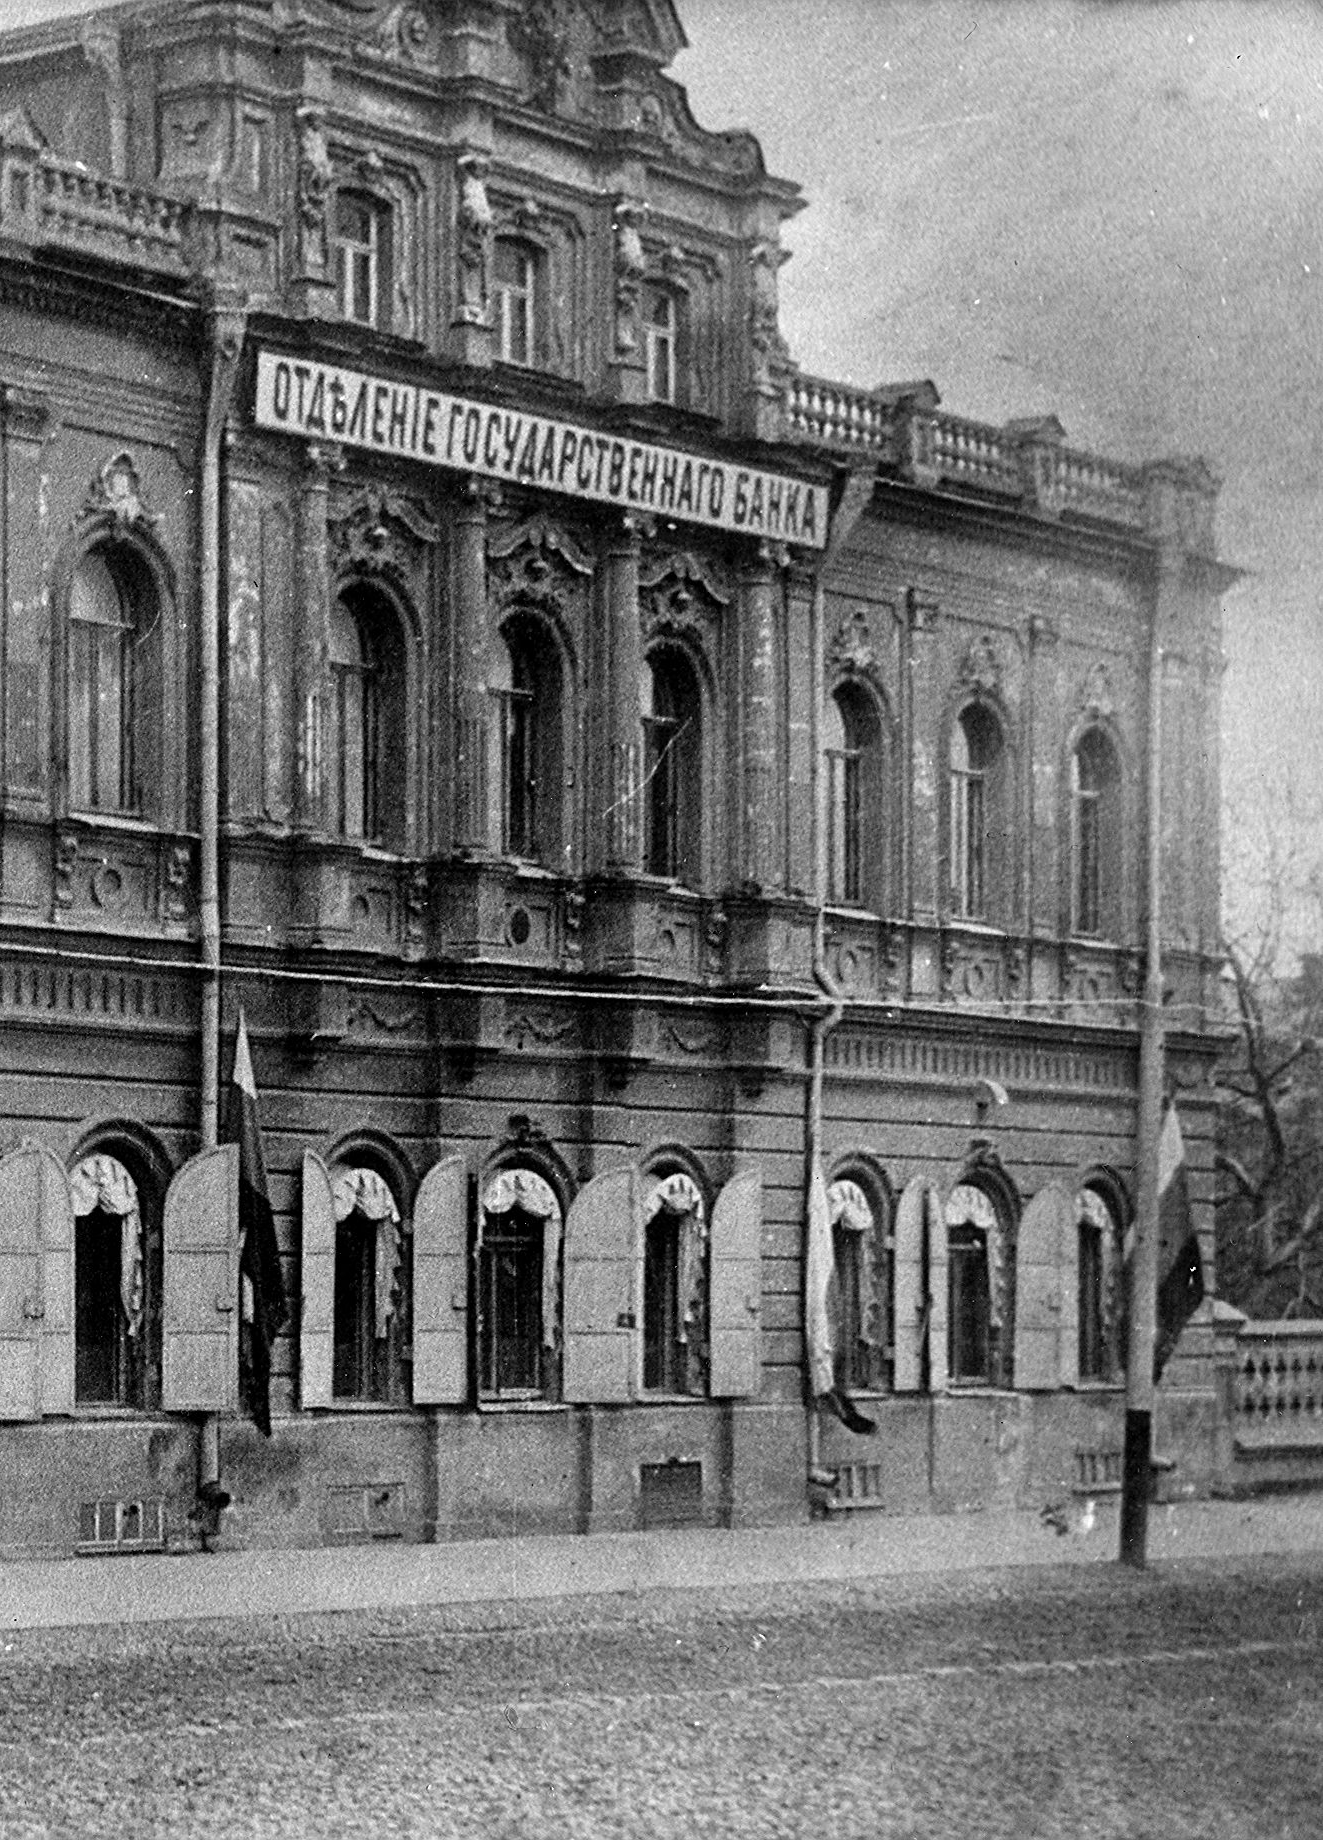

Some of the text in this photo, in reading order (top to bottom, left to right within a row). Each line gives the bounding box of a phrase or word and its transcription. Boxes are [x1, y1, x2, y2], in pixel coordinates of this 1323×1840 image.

[274, 361, 815, 539] ОТДѢЛЕНІЕ ГОСУДАРСТВЕННАГО БАНКА
